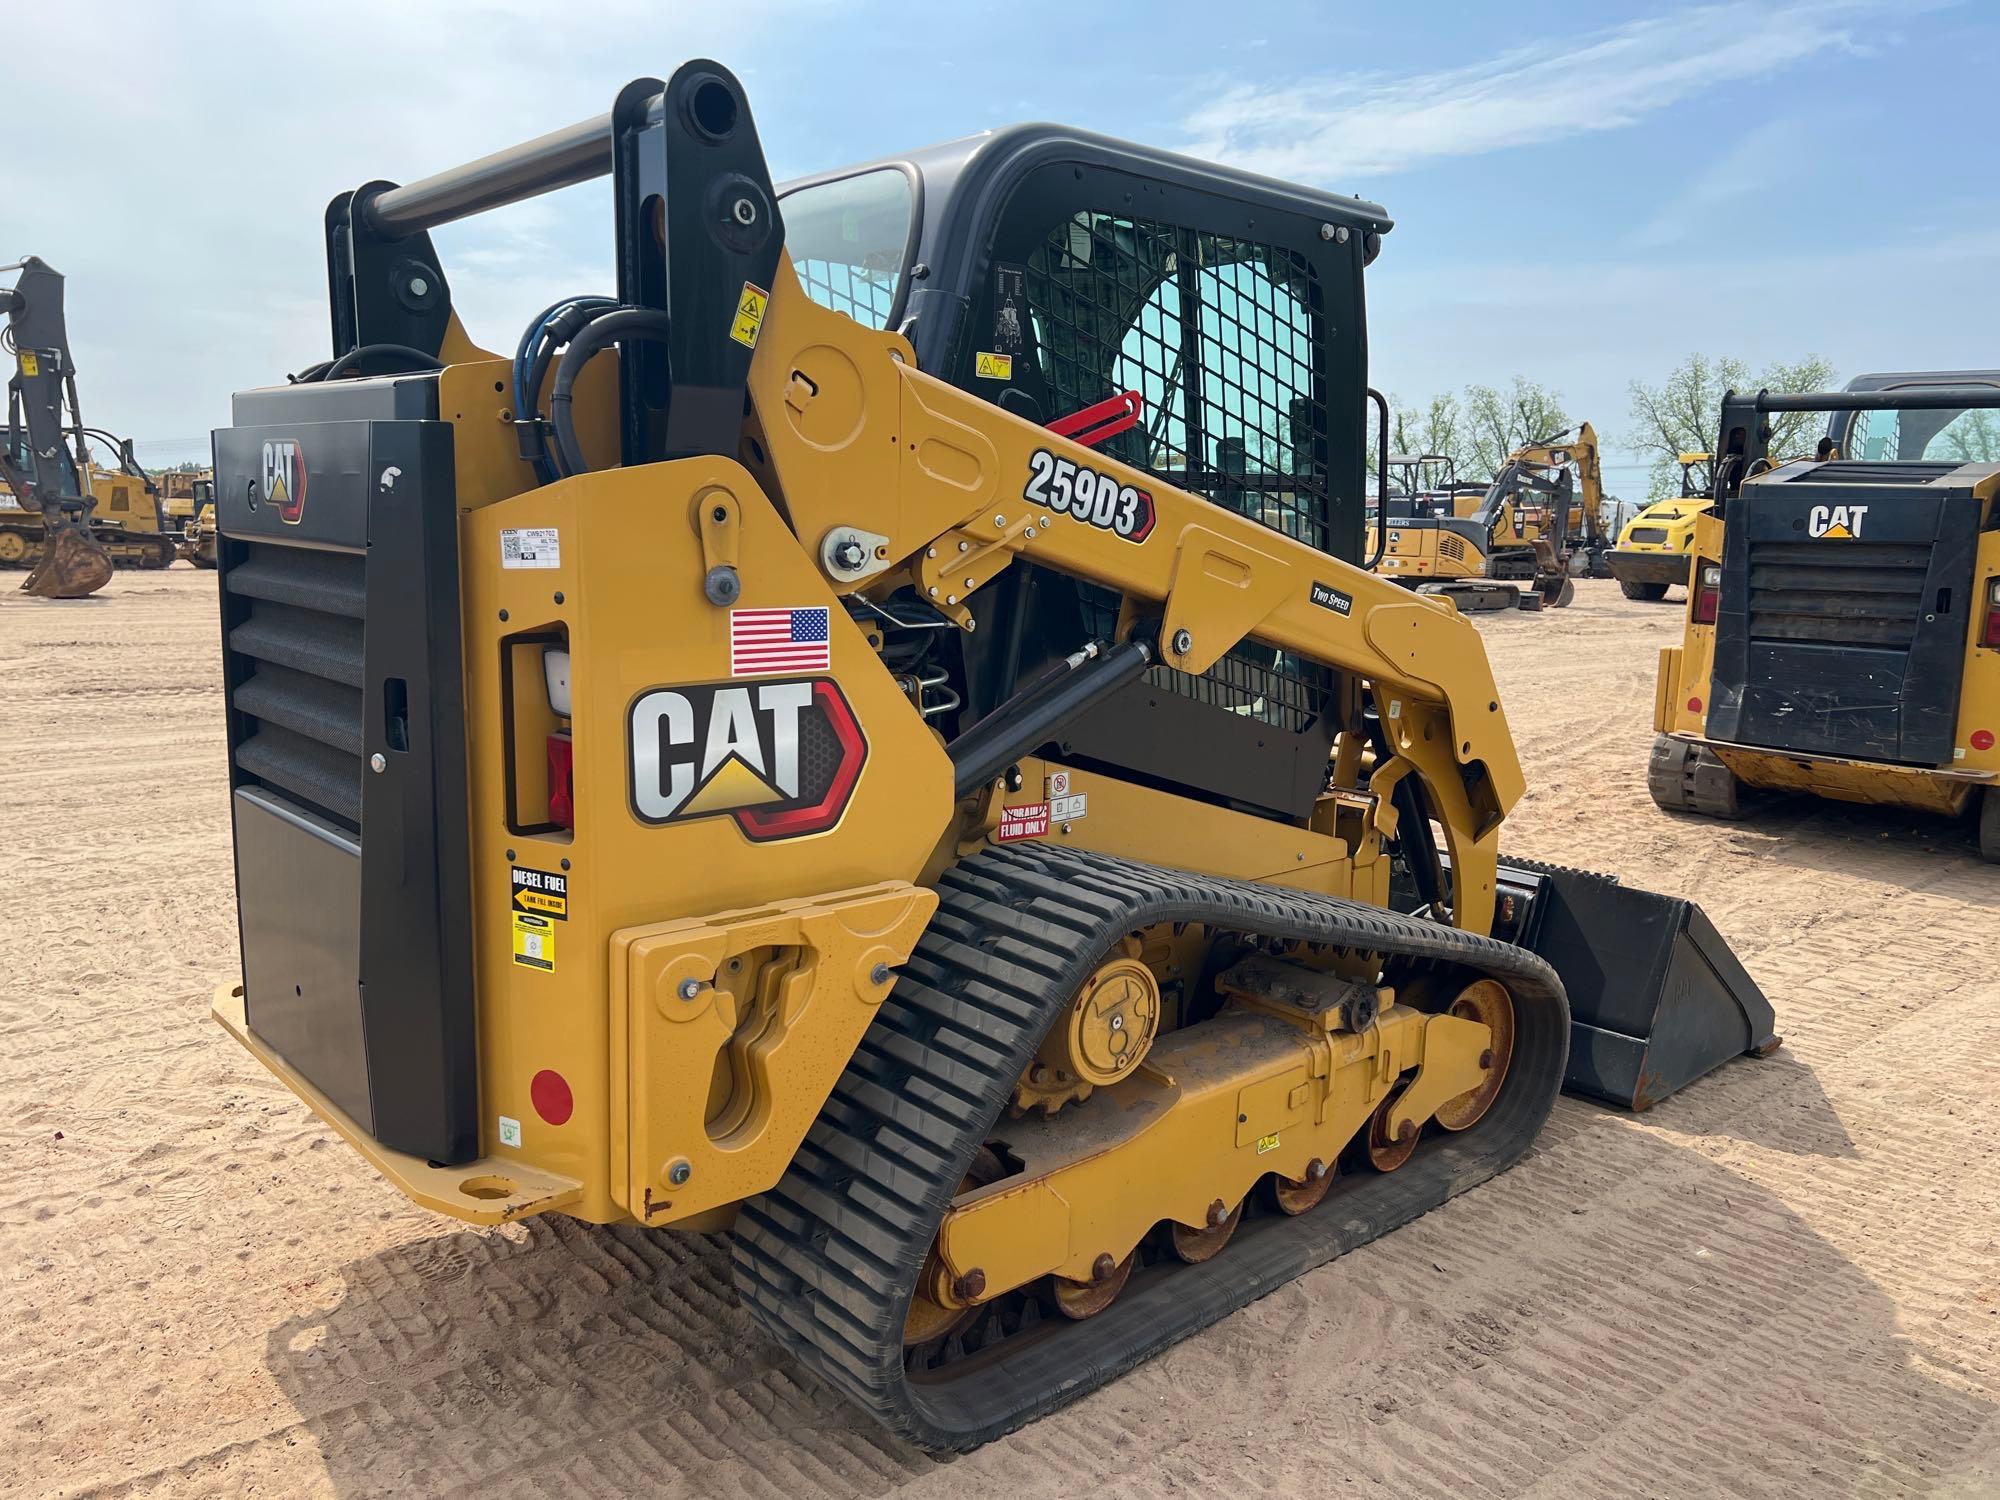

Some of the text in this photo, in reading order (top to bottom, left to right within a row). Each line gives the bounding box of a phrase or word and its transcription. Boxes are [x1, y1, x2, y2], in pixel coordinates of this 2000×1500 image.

[263, 443, 295, 502] CAT
[1025, 451, 1139, 535] 259D3
[1809, 505, 1868, 538] CAT
[633, 682, 812, 818] CAT
[1002, 805, 1048, 823] HYDRAULIC
[1001, 820, 1047, 838] FLUID ONLY
[513, 869, 566, 893] DIESEL FUEL
[524, 894, 537, 904] TANK
[537, 897, 547, 906] FILL
